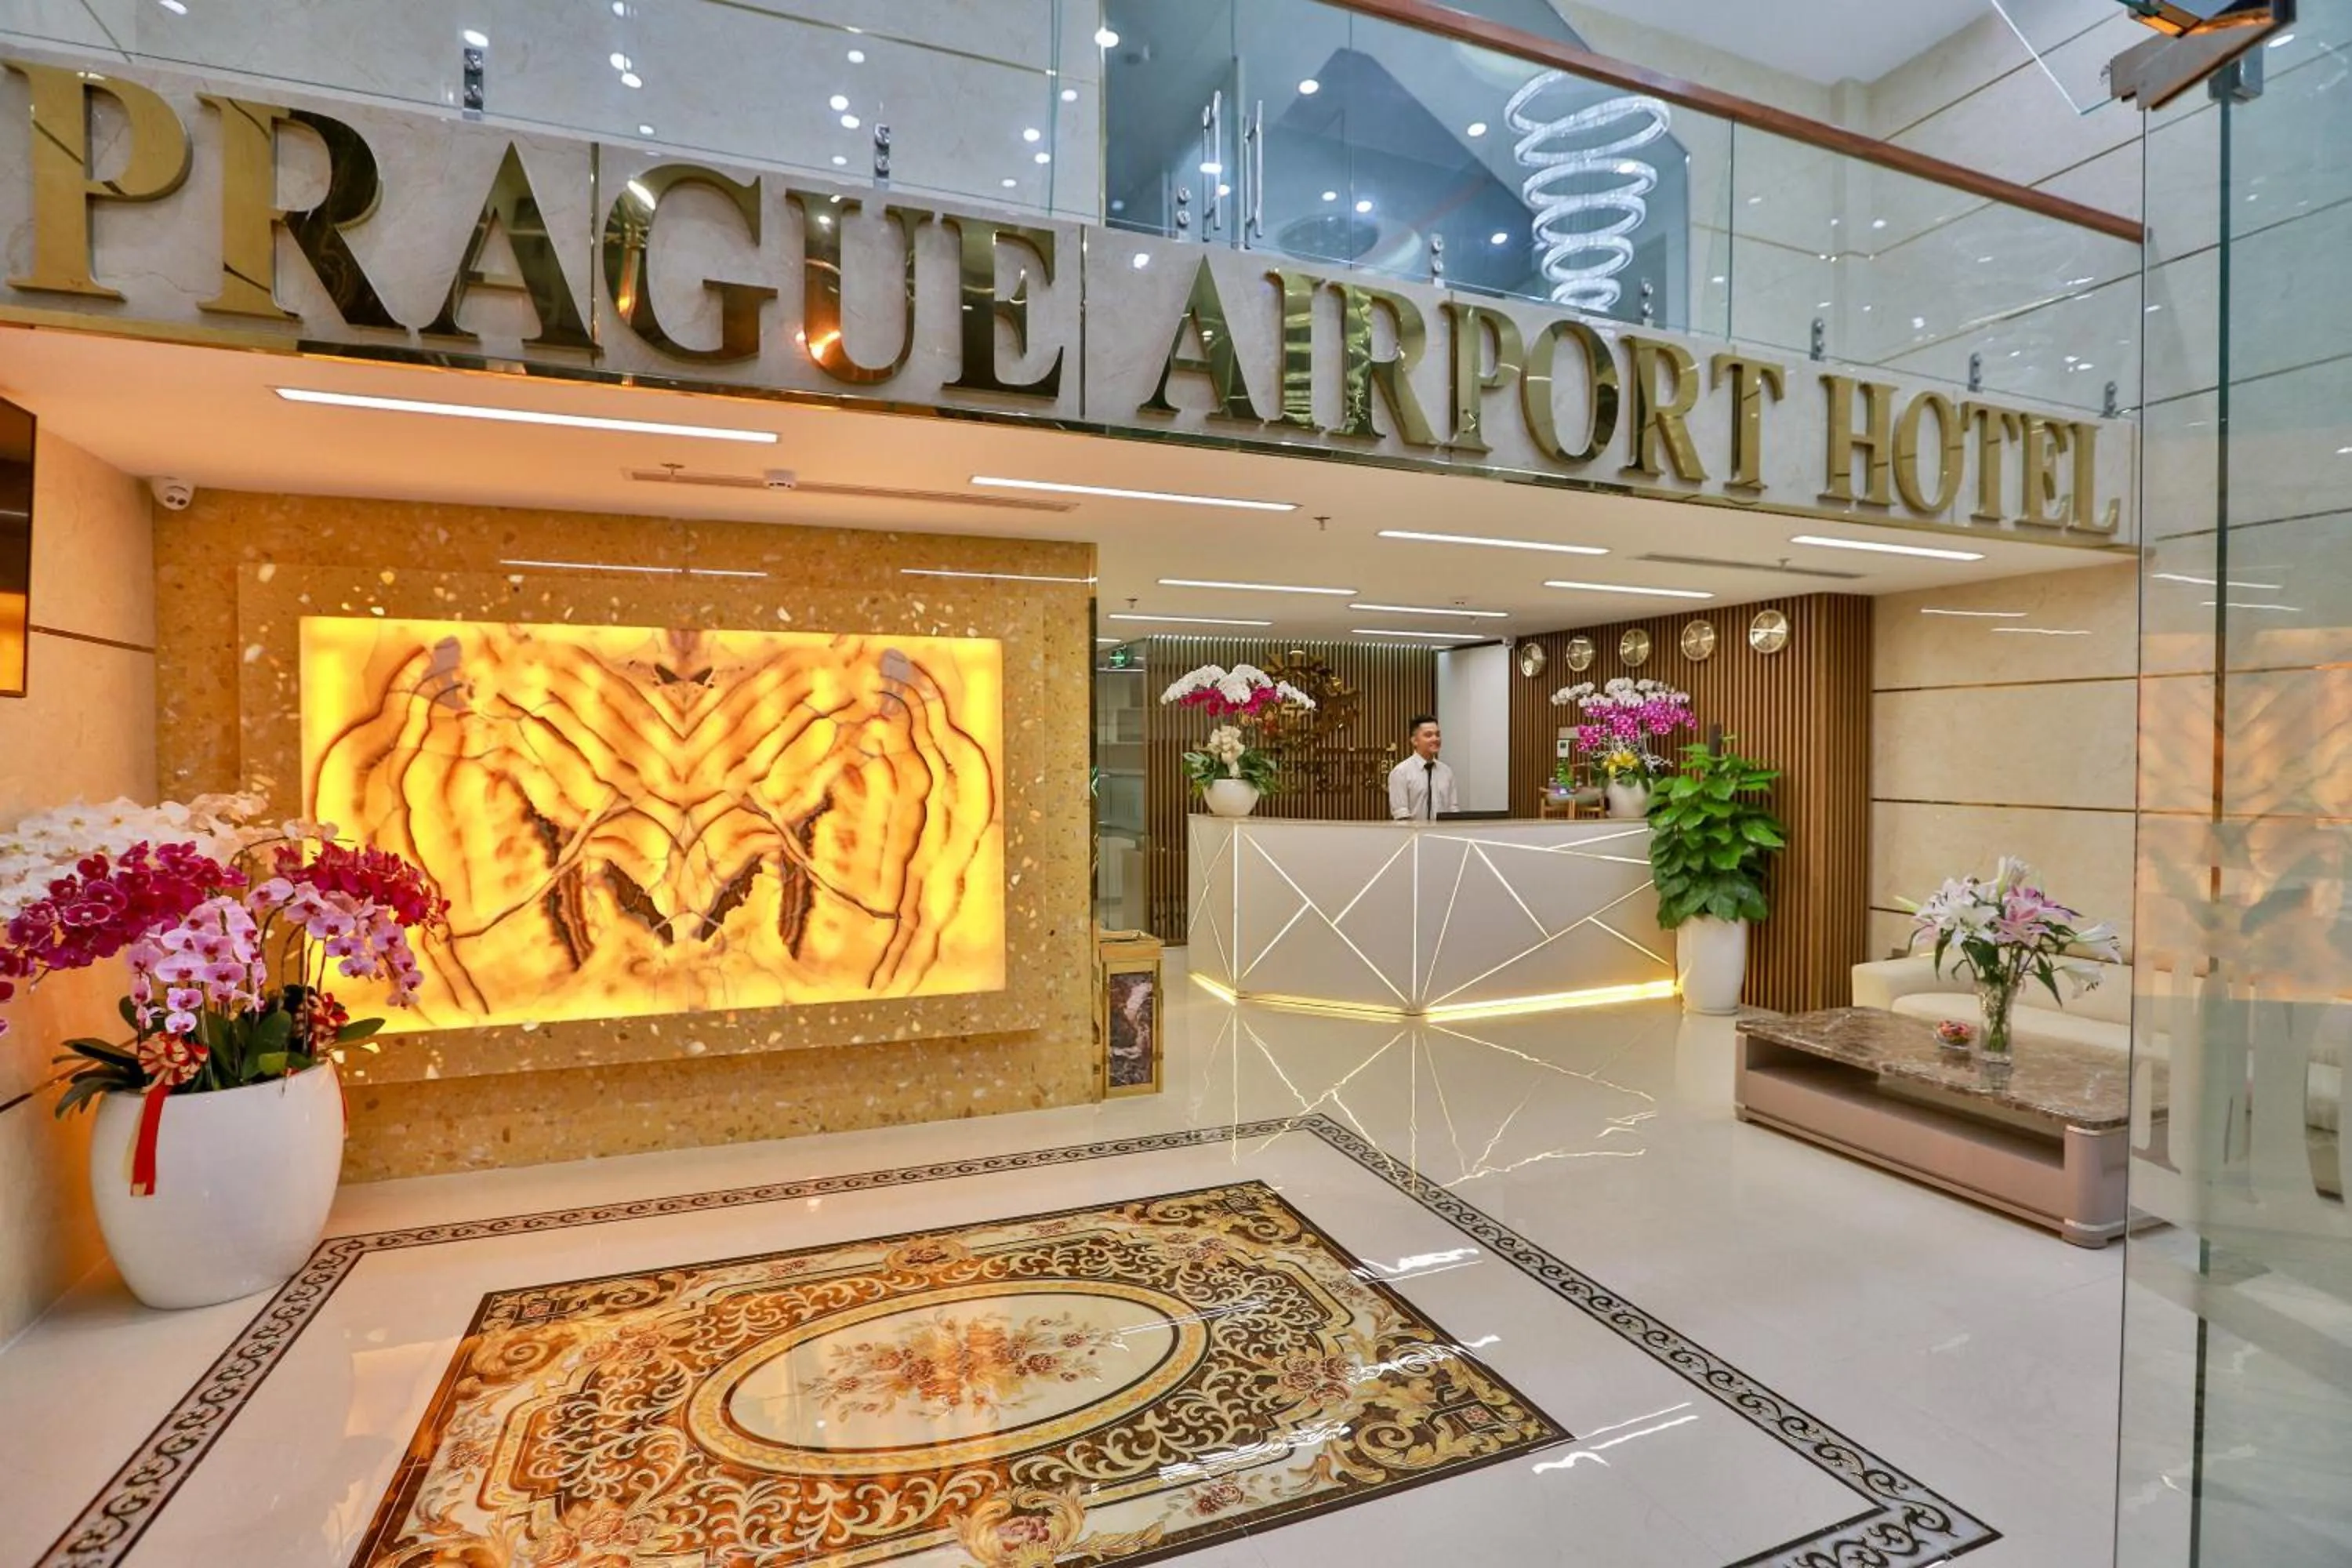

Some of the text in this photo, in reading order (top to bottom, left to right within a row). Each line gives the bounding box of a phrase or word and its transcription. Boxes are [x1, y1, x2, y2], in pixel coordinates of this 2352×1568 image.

[2, 57, 2122, 535] PRAGUE AIRPORT HOTEL
